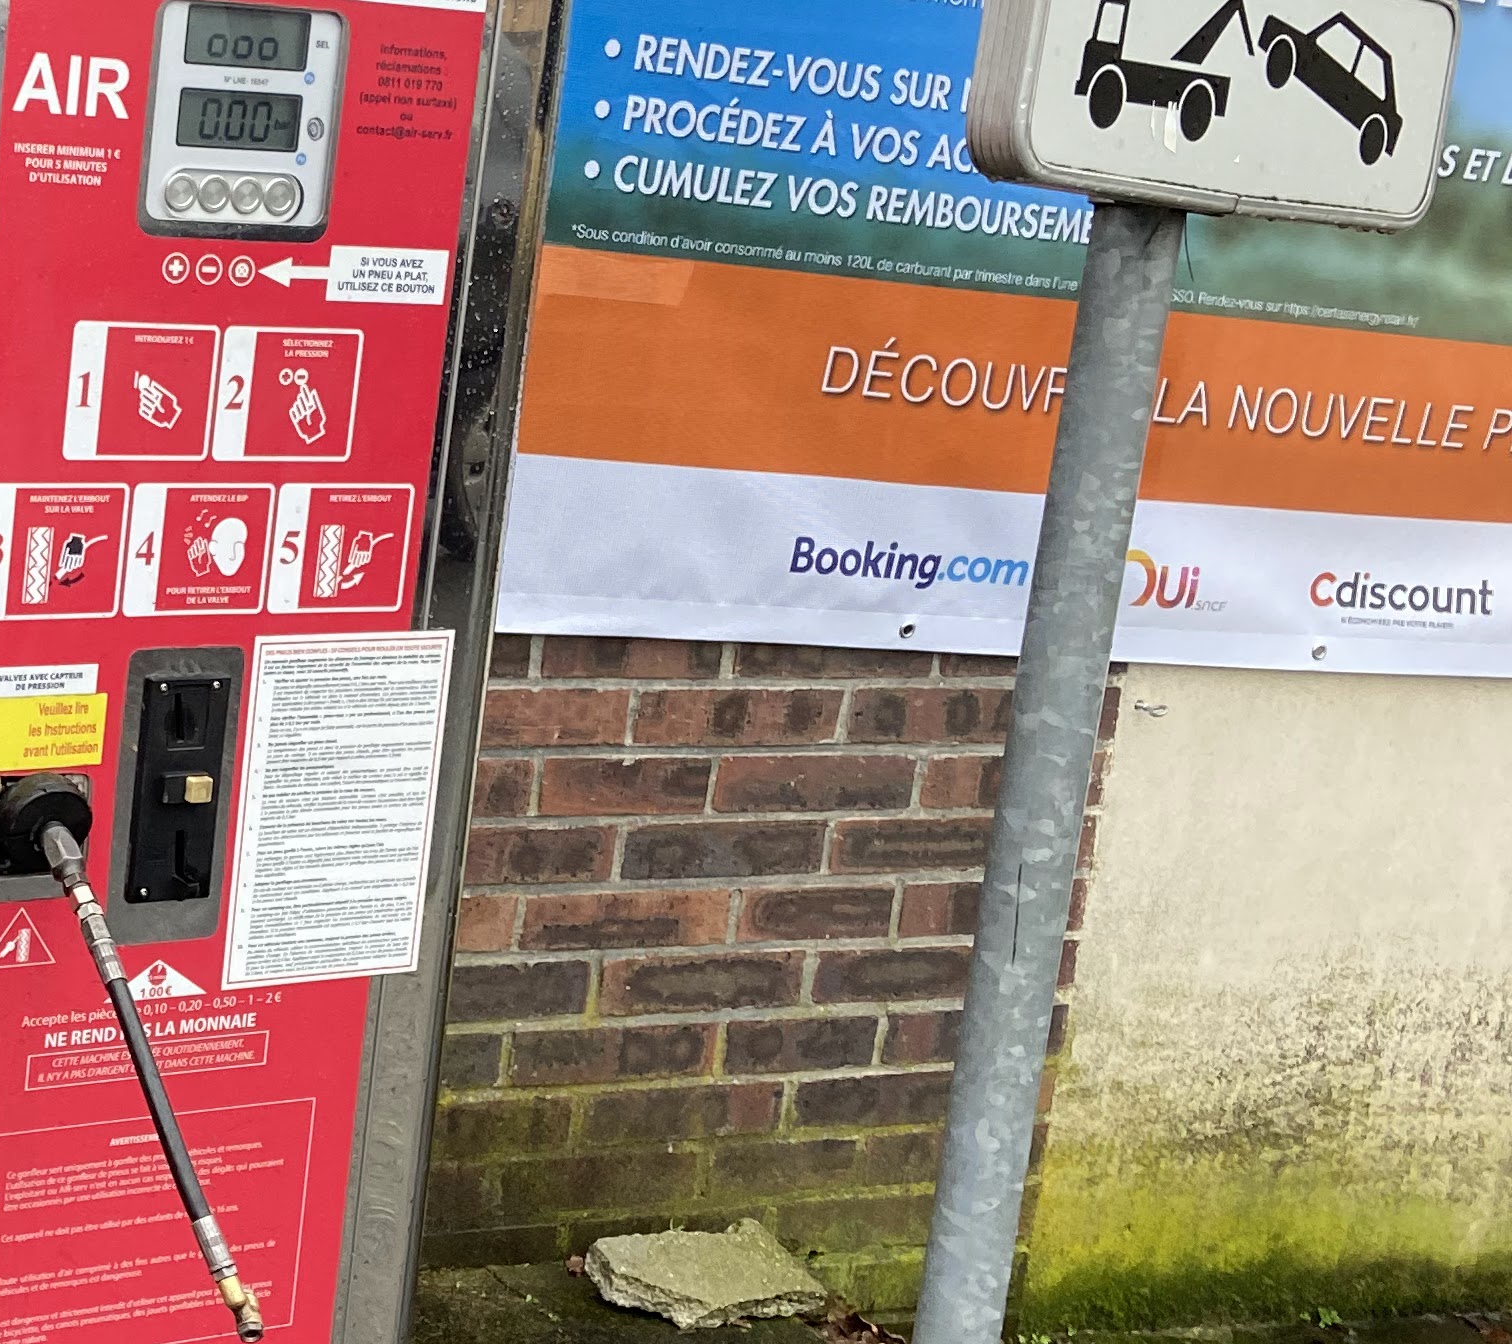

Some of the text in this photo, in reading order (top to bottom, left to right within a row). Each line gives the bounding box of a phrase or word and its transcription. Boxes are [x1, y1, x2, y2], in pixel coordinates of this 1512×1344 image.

[12, 51, 130, 120] AIR
[634, 33, 883, 102] RENDEZ-VOUS
[890, 68, 952, 111] SUR
[57, 145, 105, 159] MINIMUM
[623, 94, 807, 152] PROCÉDEZ
[810, 109, 837, 156] À
[851, 123, 921, 166] VOS
[1462, 147, 1503, 182] ET
[25, 157, 53, 170] POUR
[63, 161, 108, 173] MINUTES
[29, 172, 102, 187] D'UTILISATION
[613, 155, 779, 208] CUMULEZ
[788, 175, 859, 218] VOS
[352, 269, 366, 279] UN
[368, 269, 393, 280] PNEU
[360, 257, 424, 269] SI VOUS AVEZ
[612, 230, 668, 247] condition
[670, 235, 713, 252] d'avoir
[714, 241, 782, 260] consommé
[785, 251, 801, 262] au
[804, 250, 842, 267] moins
[847, 254, 874, 271] 120L
[877, 258, 892, 272] de
[896, 261, 952, 279] carburant
[953, 267, 974, 282] par
[975, 269, 1023, 287] trimestre
[1025, 274, 1052, 289] dans
[1266, 299, 1280, 312] sur
[338, 281, 435, 294] UTILISEZ CE BOUTON
[75, 371, 91, 408] 1
[224, 375, 246, 411] 2
[1152, 377, 1208, 427] LA
[1227, 384, 1475, 449] NOUVELLE
[135, 531, 155, 566] 4
[280, 531, 301, 565] 5
[789, 536, 1030, 589] Booking.com
[1310, 571, 1495, 617] Cdiscount
[0, 674, 27, 682] VALVES
[29, 673, 48, 681] AVEC
[28, 682, 65, 690] PRESSION
[39, 701, 89, 716] Veuillez lire
[29, 724, 42, 737] les
[23, 744, 48, 757] avant
[21, 1013, 68, 1028] Accepte
[70, 1010, 86, 1023] les
[143, 1003, 168, 1016] 0,10
[178, 999, 203, 1013] 0,20
[213, 996, 237, 1009] 0,50
[44, 1031, 67, 1049] NE
[70, 1027, 117, 1046] REND
[154, 1020, 176, 1037] LA
[179, 1012, 257, 1035] MONNAIE
